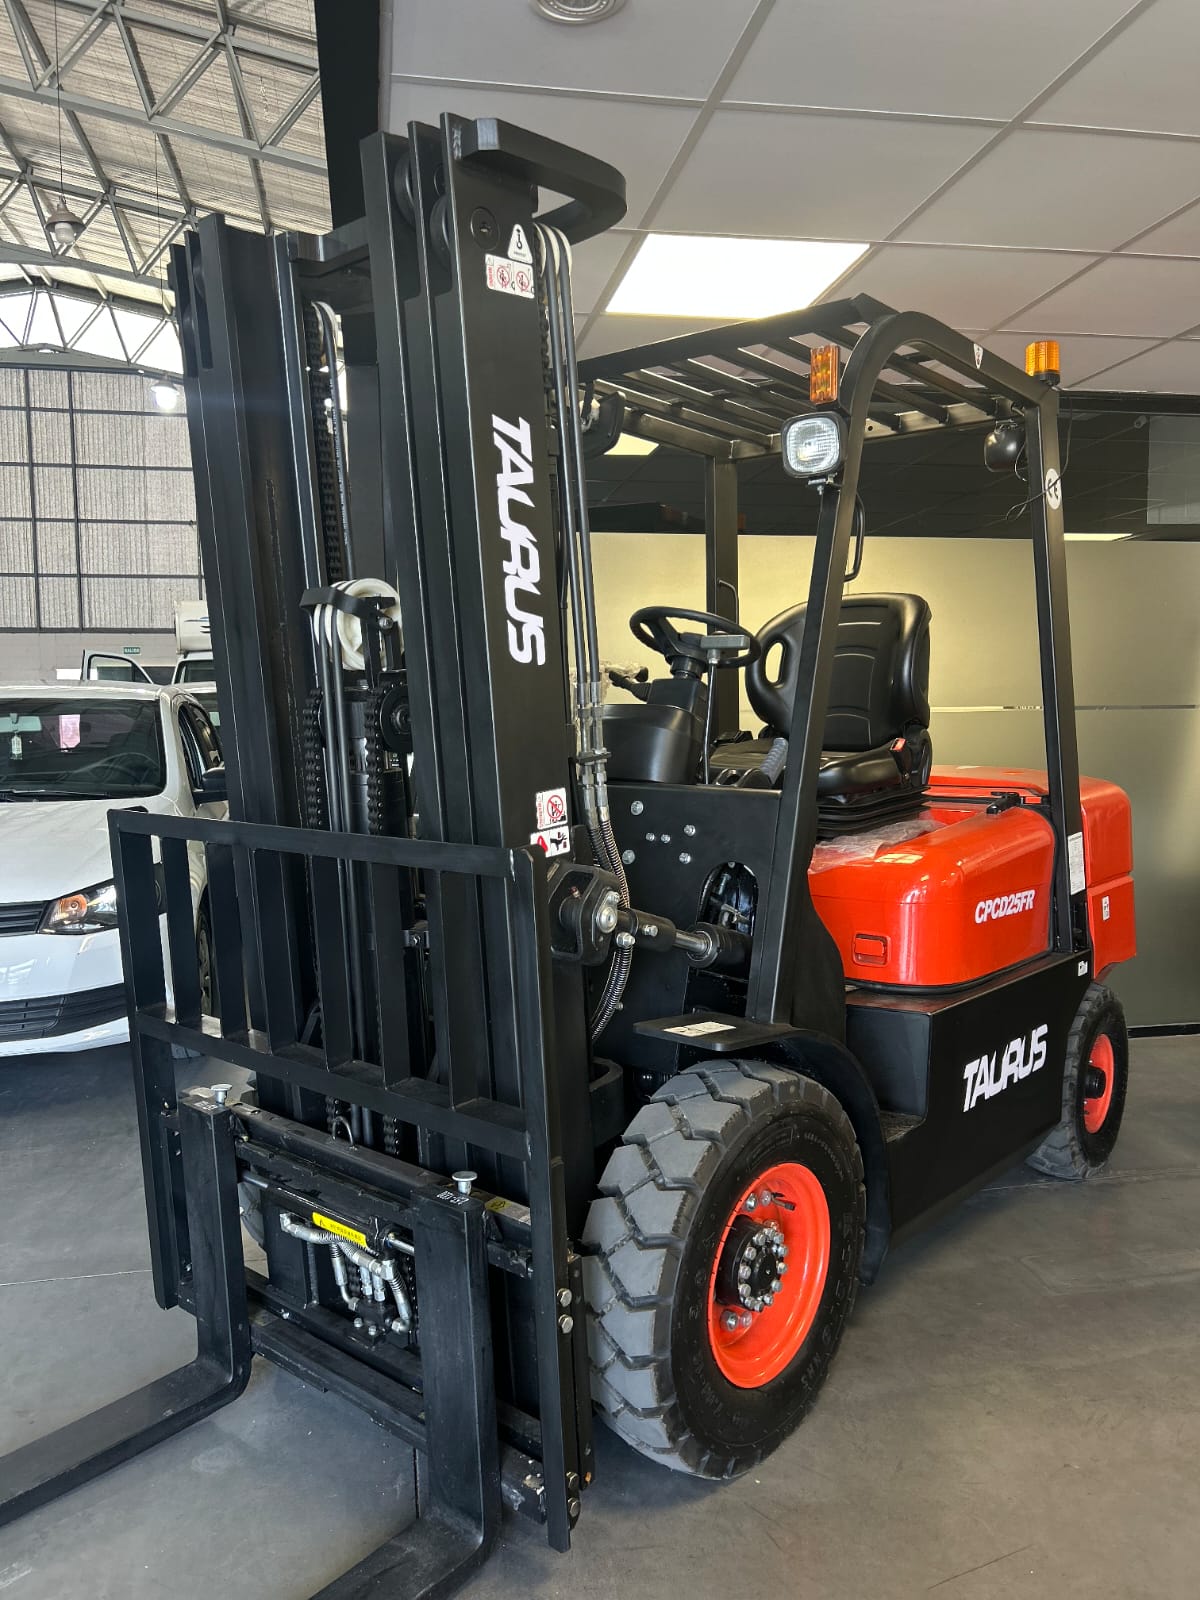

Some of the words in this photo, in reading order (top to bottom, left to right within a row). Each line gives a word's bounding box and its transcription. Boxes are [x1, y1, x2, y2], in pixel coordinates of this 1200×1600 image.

[491, 413, 546, 666] TAURUS
[975, 889, 1035, 924] CPCD25FR
[963, 1023, 1048, 1112] TAURUS
